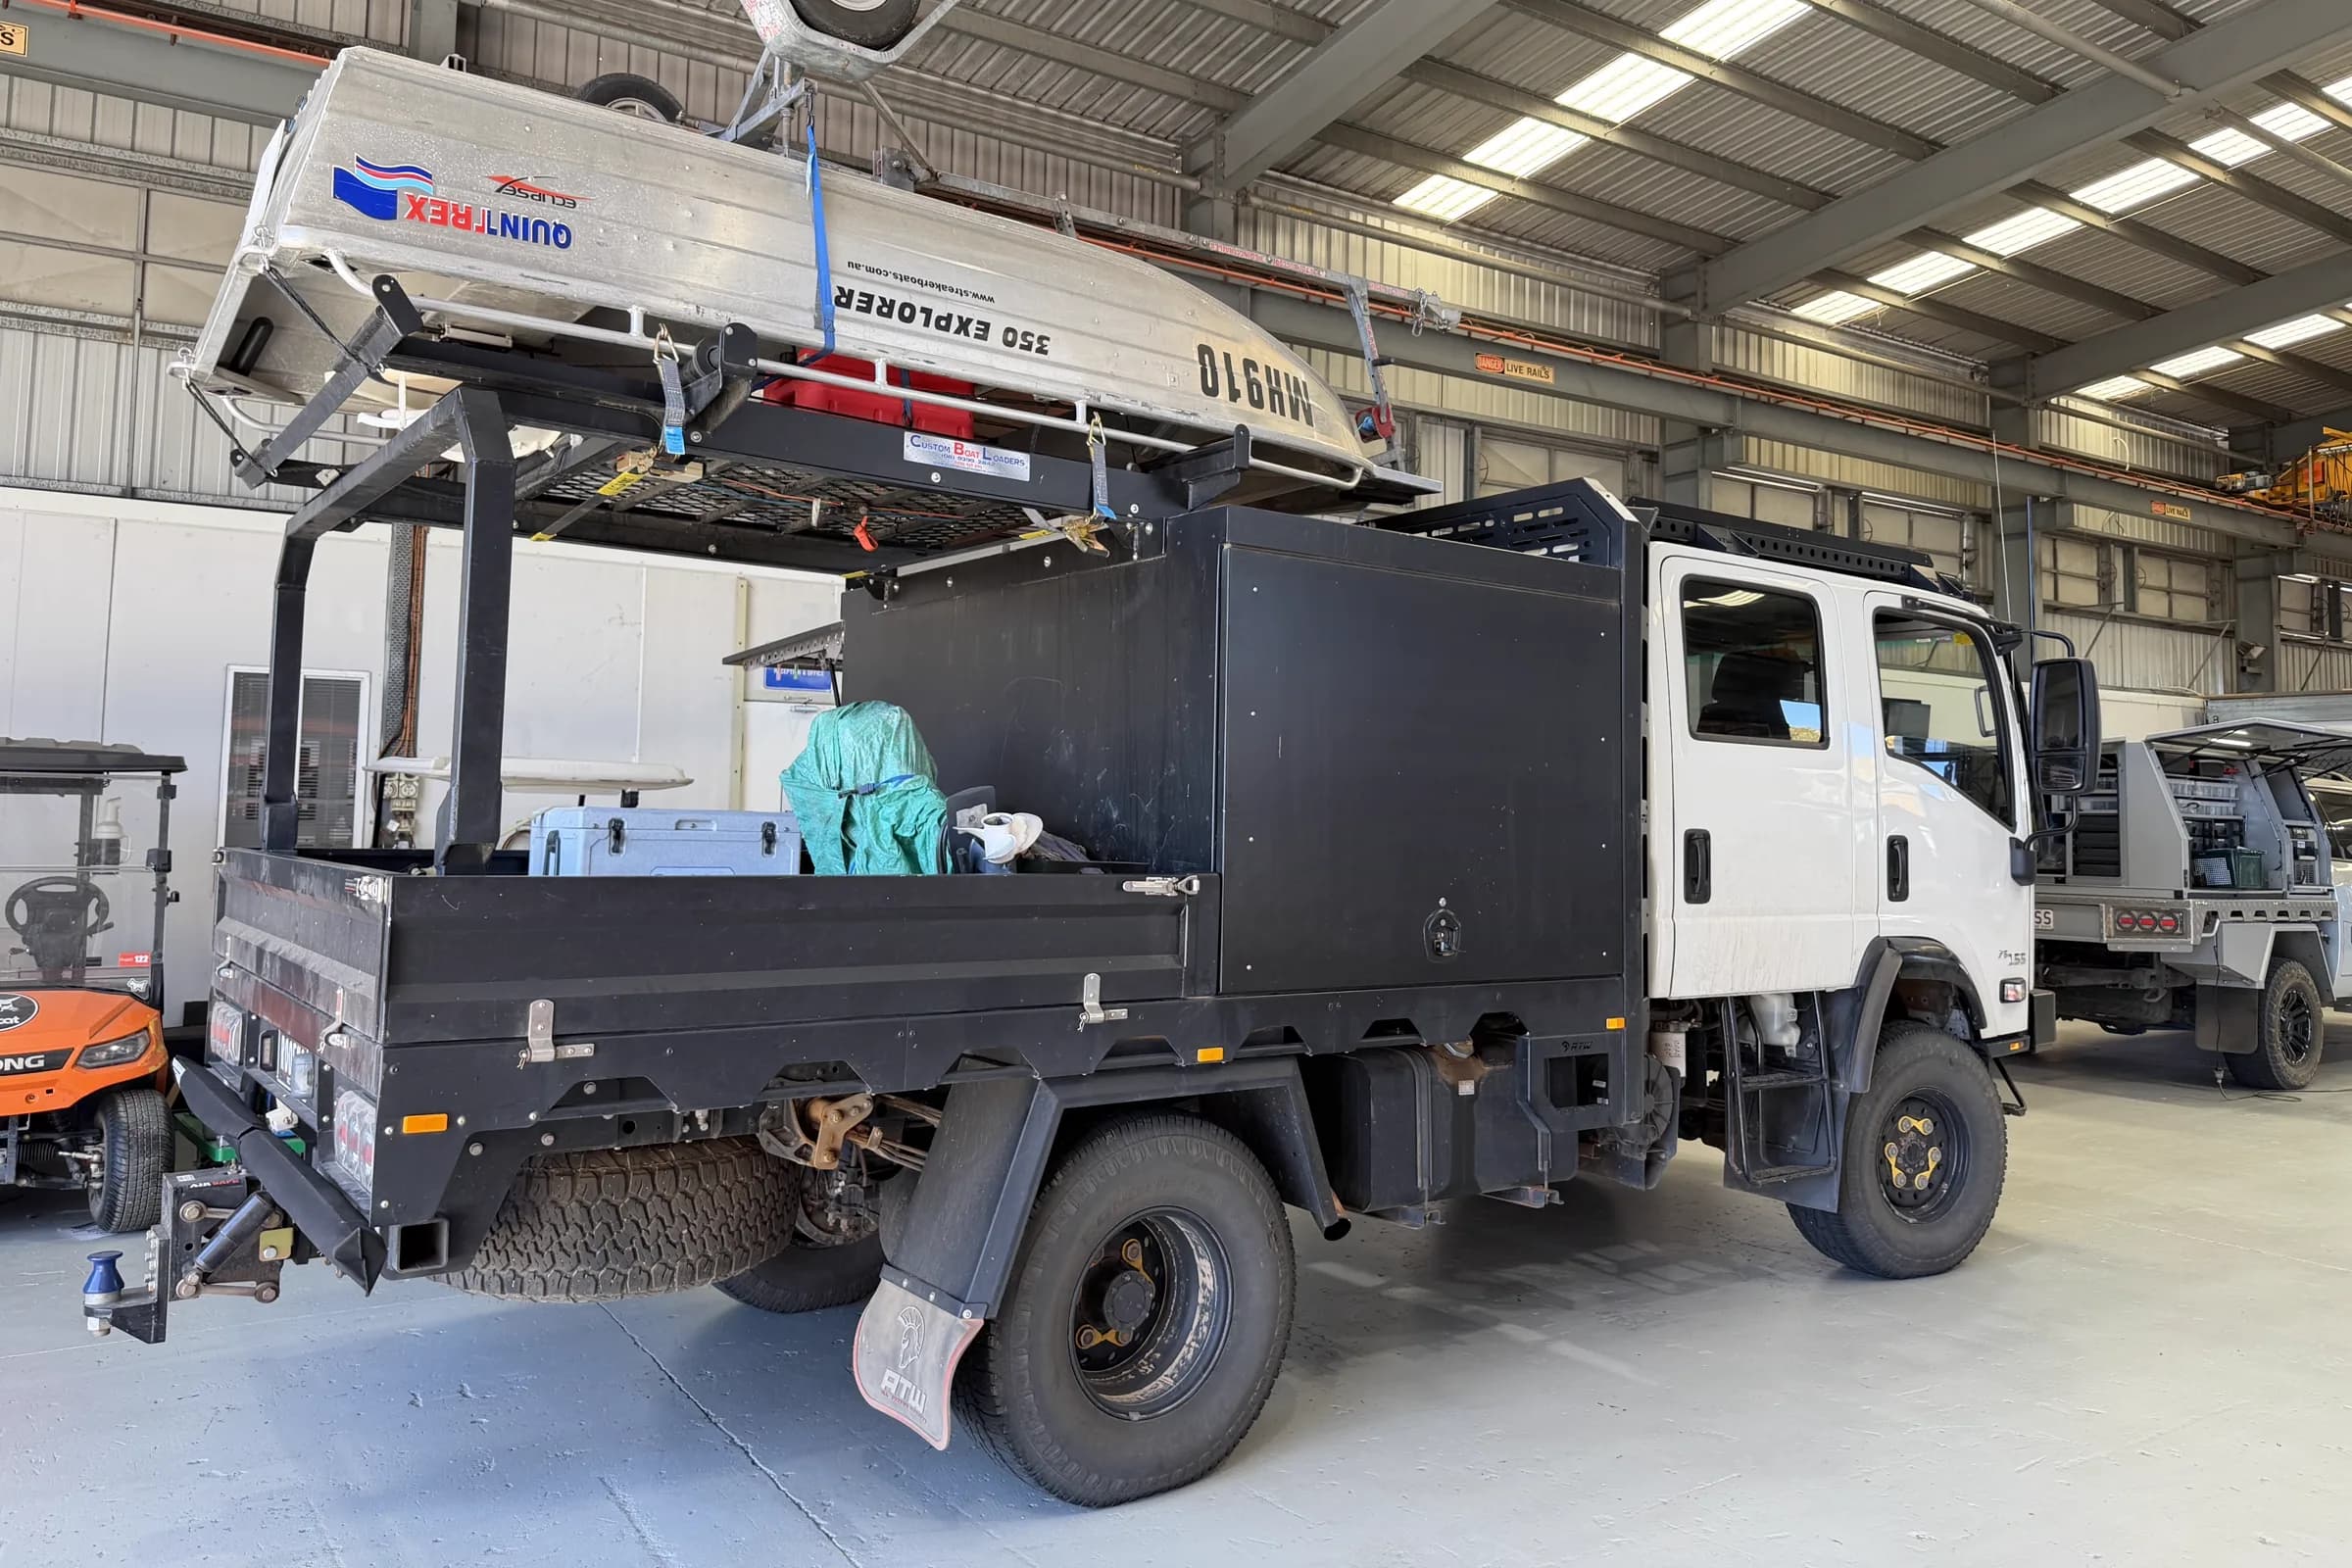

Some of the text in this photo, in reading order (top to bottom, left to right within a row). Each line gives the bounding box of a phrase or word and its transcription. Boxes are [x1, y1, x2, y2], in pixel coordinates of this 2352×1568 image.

[404, 192, 573, 251] QUINTREX
[847, 260, 996, 304] www.streakerboats.com.au
[834, 284, 1052, 356] 350 EXPLORER
[1197, 343, 1314, 428] MH910
[1506, 364, 1524, 374] LIVE
[1527, 368, 1550, 379] RAILS
[909, 434, 951, 454] CUSTOM
[954, 442, 981, 460] BOAT
[982, 447, 1026, 467] LOADERS
[0, 1054, 45, 1071] NG
